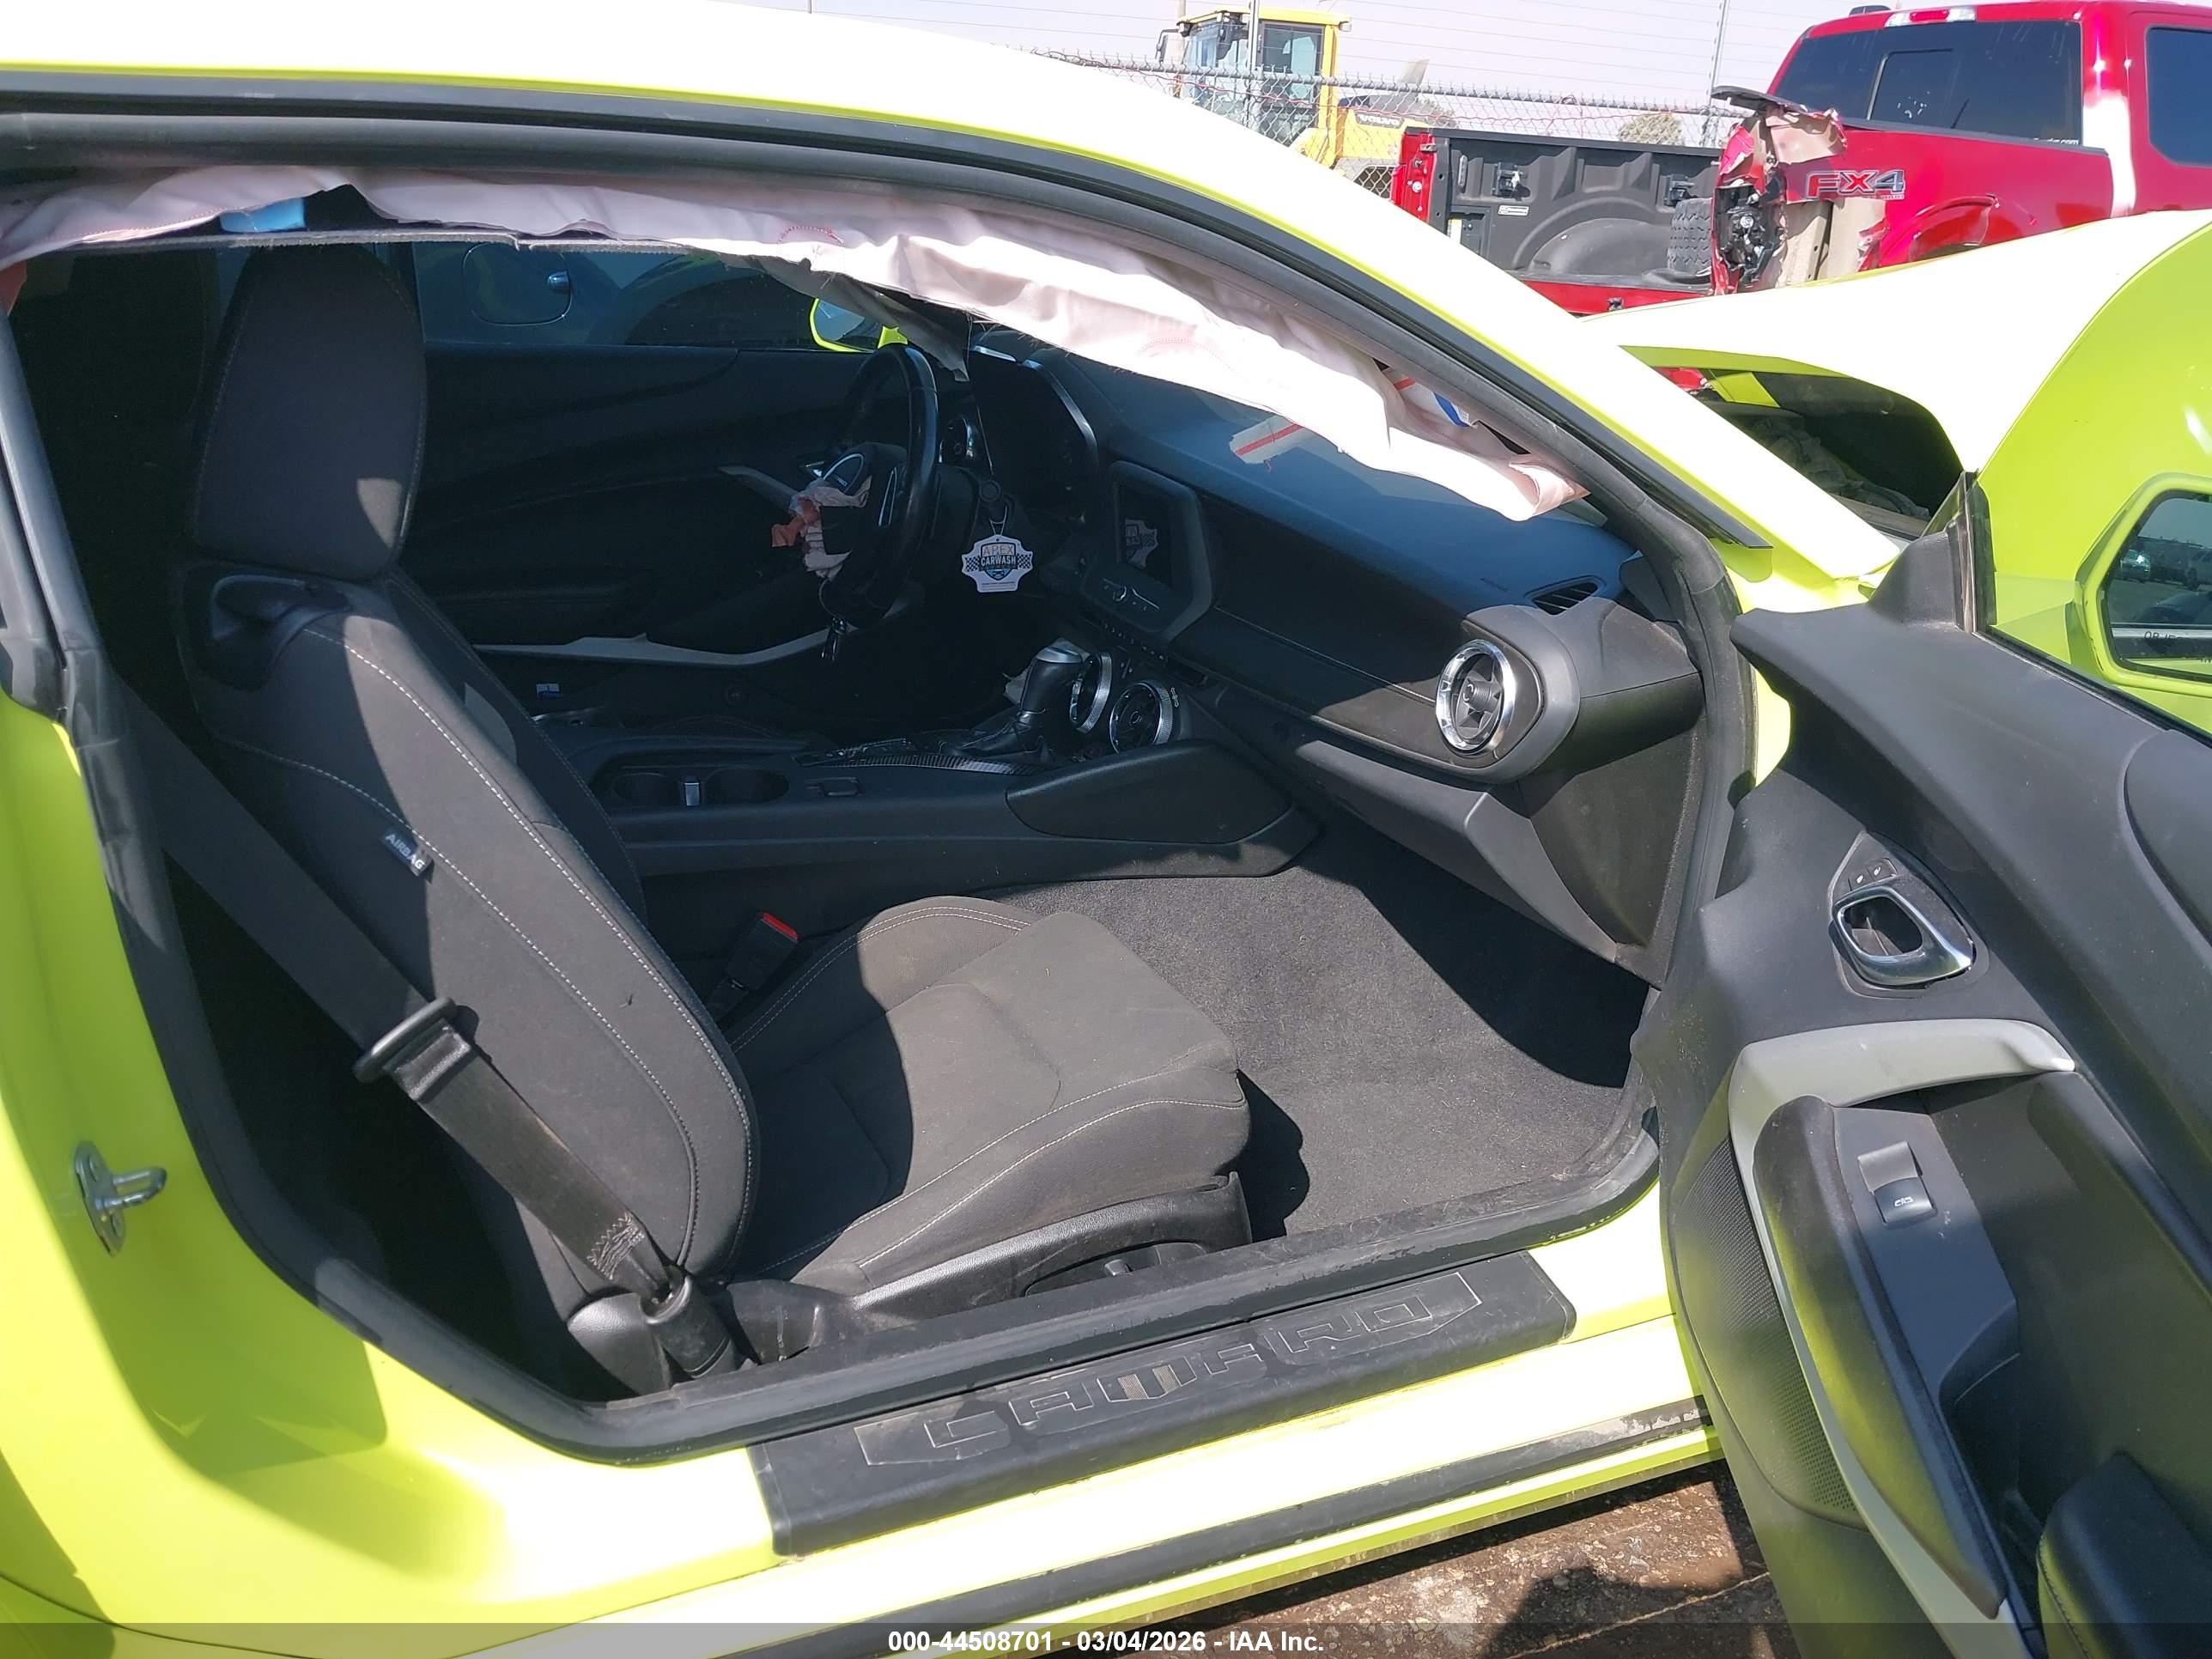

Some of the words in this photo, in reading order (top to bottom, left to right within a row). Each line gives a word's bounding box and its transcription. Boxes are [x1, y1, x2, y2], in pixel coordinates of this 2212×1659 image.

[1358, 114, 1400, 126] VOLVO
[1807, 170, 1905, 199] FX4
[982, 544, 1014, 556] APEX
[981, 556, 1016, 566] CARWASH
[386, 834, 426, 870] AIRBAG
[924, 1296, 1432, 1449] CAMARO
